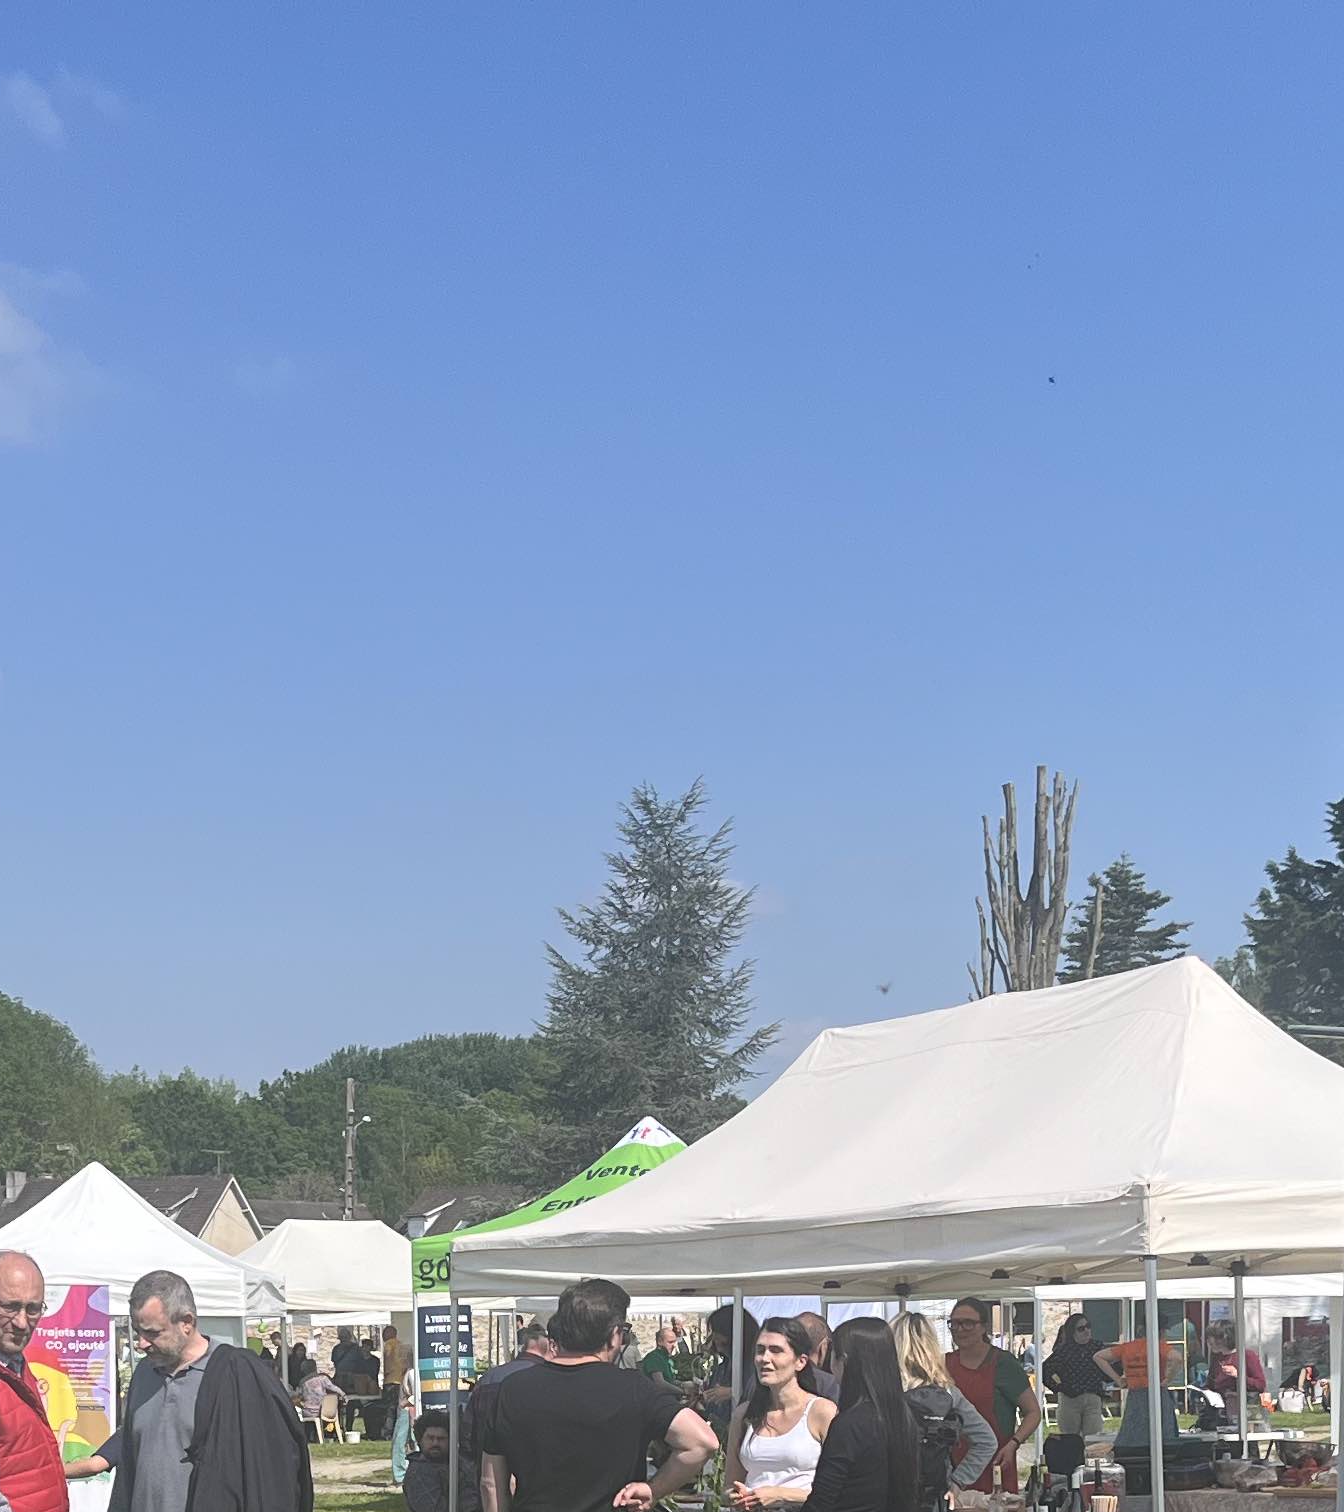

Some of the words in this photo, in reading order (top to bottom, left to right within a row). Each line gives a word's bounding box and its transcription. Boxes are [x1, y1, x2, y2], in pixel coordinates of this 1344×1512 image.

[36, 1327, 76, 1340] Trajets
[77, 1328, 105, 1338] sans
[67, 1340, 105, 1352] ajouté
[430, 1341, 468, 1354] Teeke
